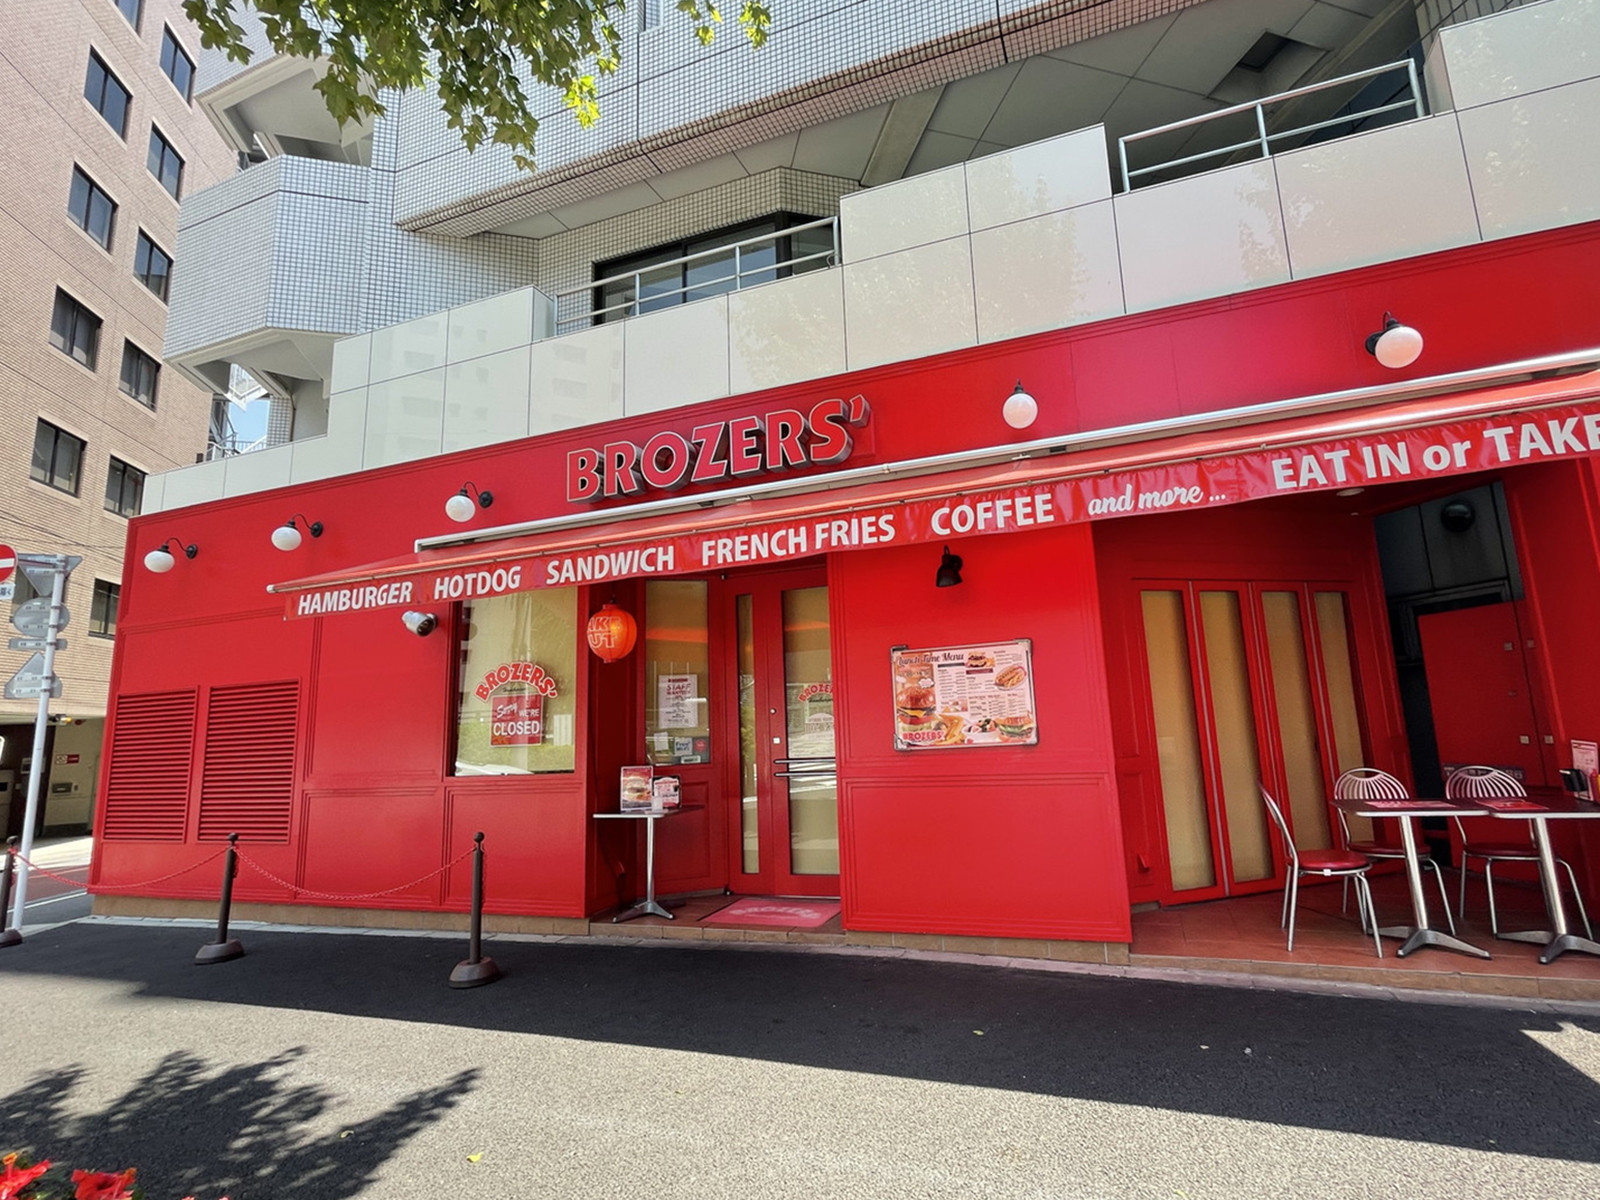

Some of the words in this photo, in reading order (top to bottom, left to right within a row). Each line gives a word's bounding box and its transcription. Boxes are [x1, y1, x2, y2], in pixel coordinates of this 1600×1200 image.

[567, 394, 871, 503] BROZERS'
[297, 581, 413, 616] HAMBURGER
[434, 565, 522, 600] HOTDOG
[546, 545, 675, 585] SANDWICH
[702, 526, 807, 566] FRENCH
[815, 513, 896, 549] FRIES
[931, 493, 1055, 536] COFFEE
[1088, 484, 1134, 515] and
[1272, 449, 1351, 490] EAT
[1362, 441, 1411, 479] IN
[1423, 440, 1472, 472] or
[1483, 412, 1600, 462] TAKE
[941, 652, 964, 662] Menu
[475, 662, 558, 701] BROZERS'
[666, 683, 692, 691] STAFF
[799, 684, 833, 702] BROZE
[519, 708, 540, 718] WE'RE
[493, 720, 541, 736] CLOSED
